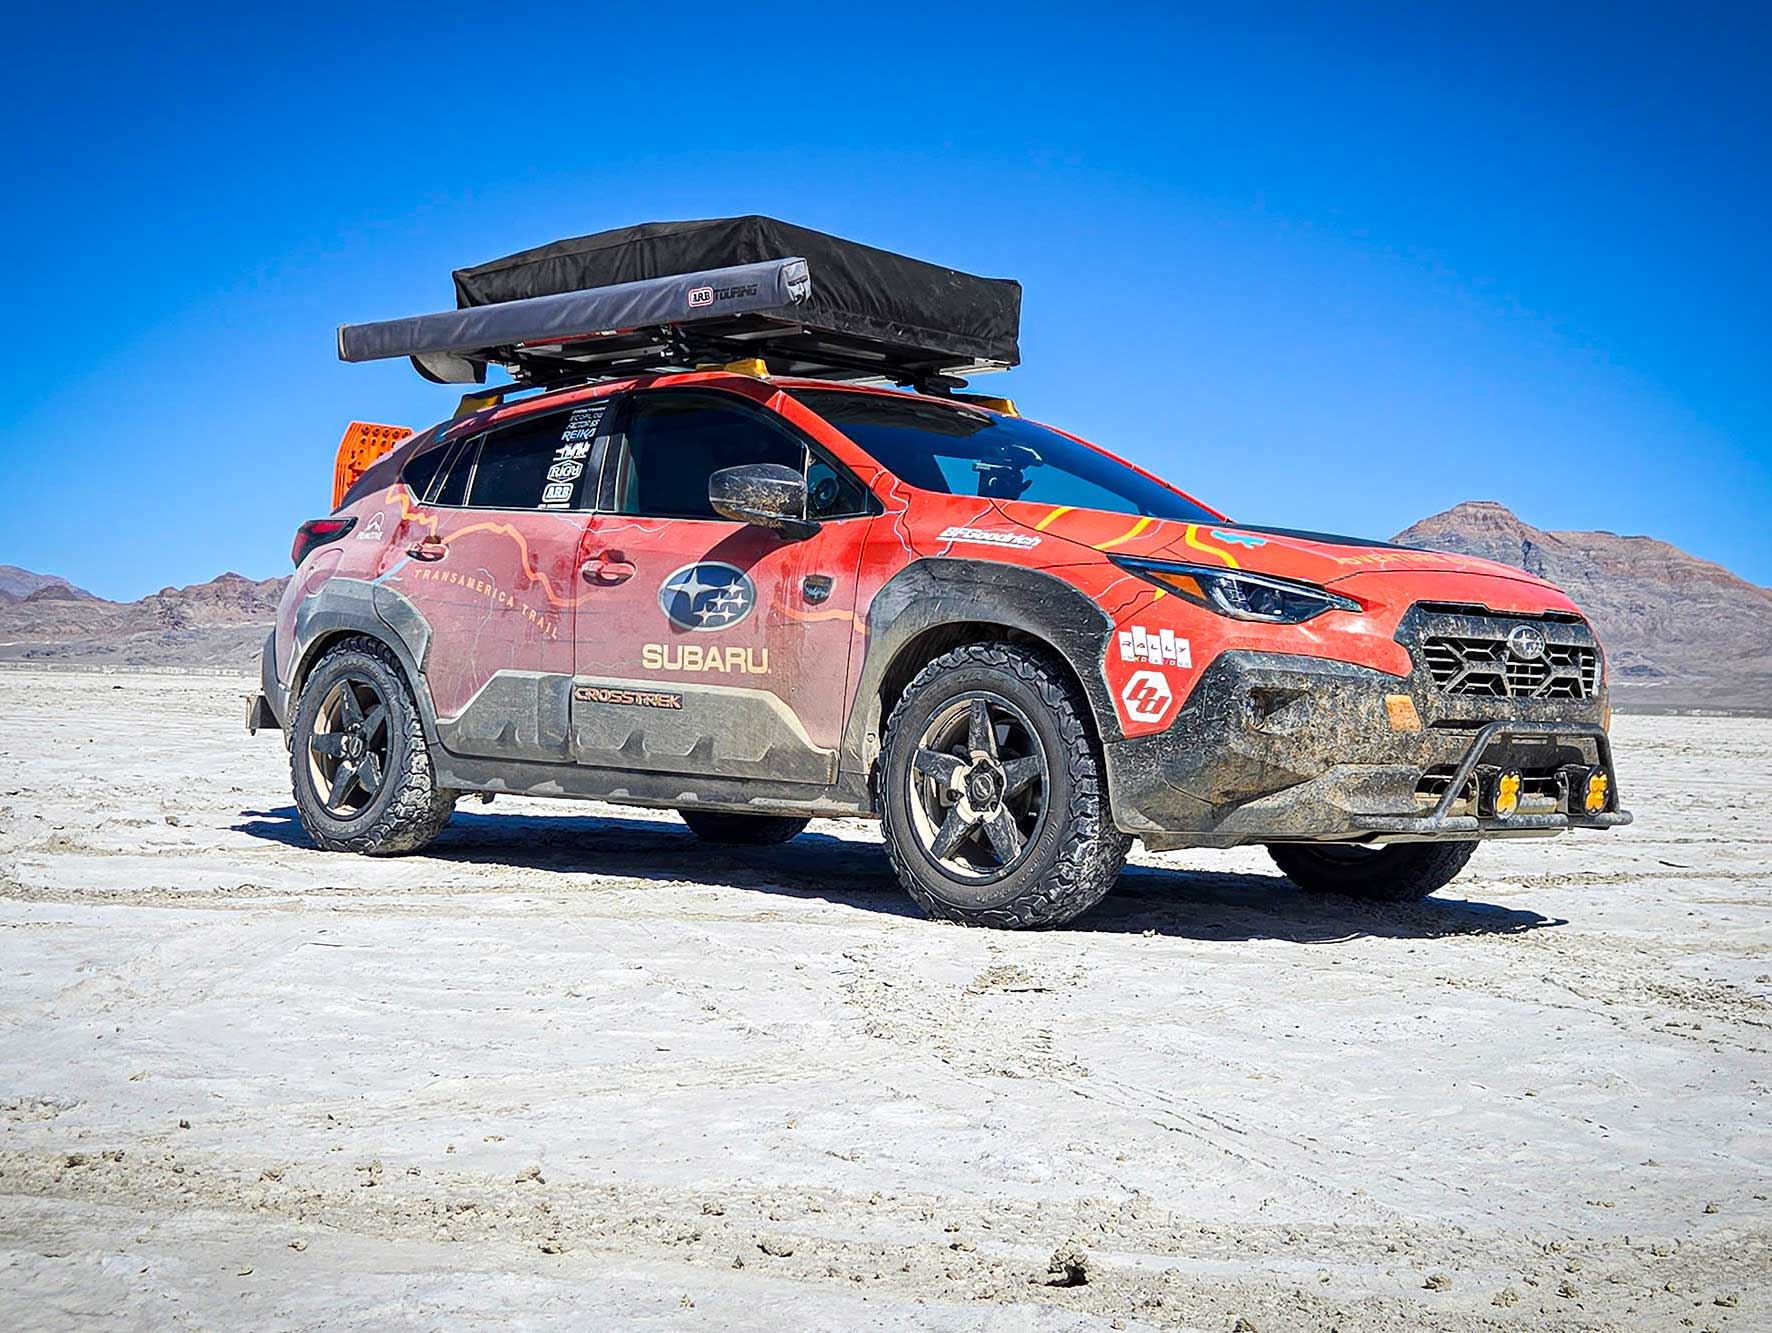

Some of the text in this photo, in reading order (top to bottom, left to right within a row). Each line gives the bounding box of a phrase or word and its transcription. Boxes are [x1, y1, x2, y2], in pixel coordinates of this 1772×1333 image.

[713, 284, 758, 300] TOURING
[545, 486, 571, 498] ARB
[939, 526, 1042, 547] BFGoodrich
[415, 569, 558, 640] TRANSAMERICA TRAIL
[642, 643, 768, 674] SUBARU
[574, 688, 682, 709] CROSSTREK
